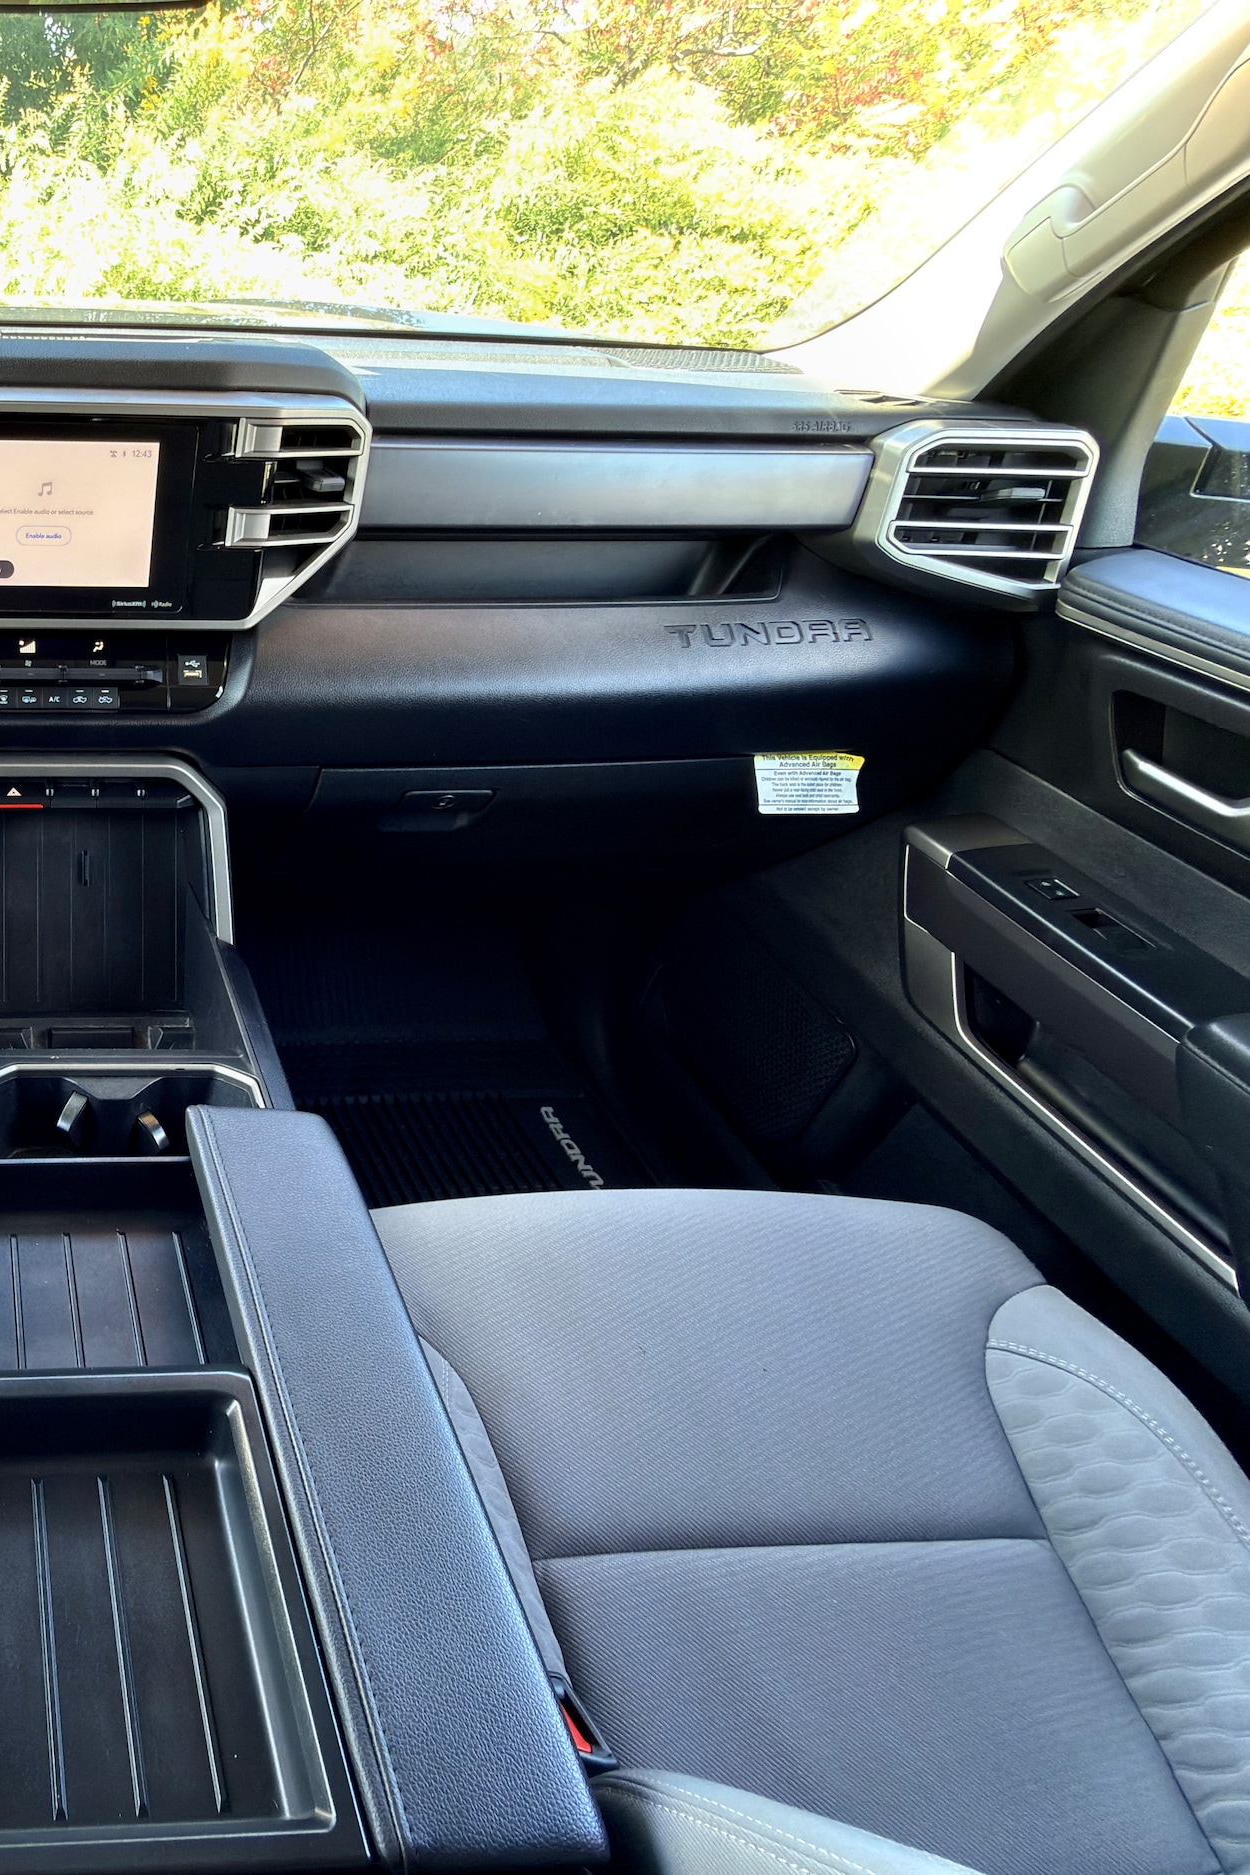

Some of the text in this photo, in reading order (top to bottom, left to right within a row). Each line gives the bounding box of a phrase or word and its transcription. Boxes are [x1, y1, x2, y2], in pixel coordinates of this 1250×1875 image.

[132, 450, 152, 458] 12:43
[664, 618, 873, 648] TUNDRA
[809, 754, 837, 763] Equipped
[822, 761, 836, 769] Bags
[540, 1106, 604, 1190] UNDRA
